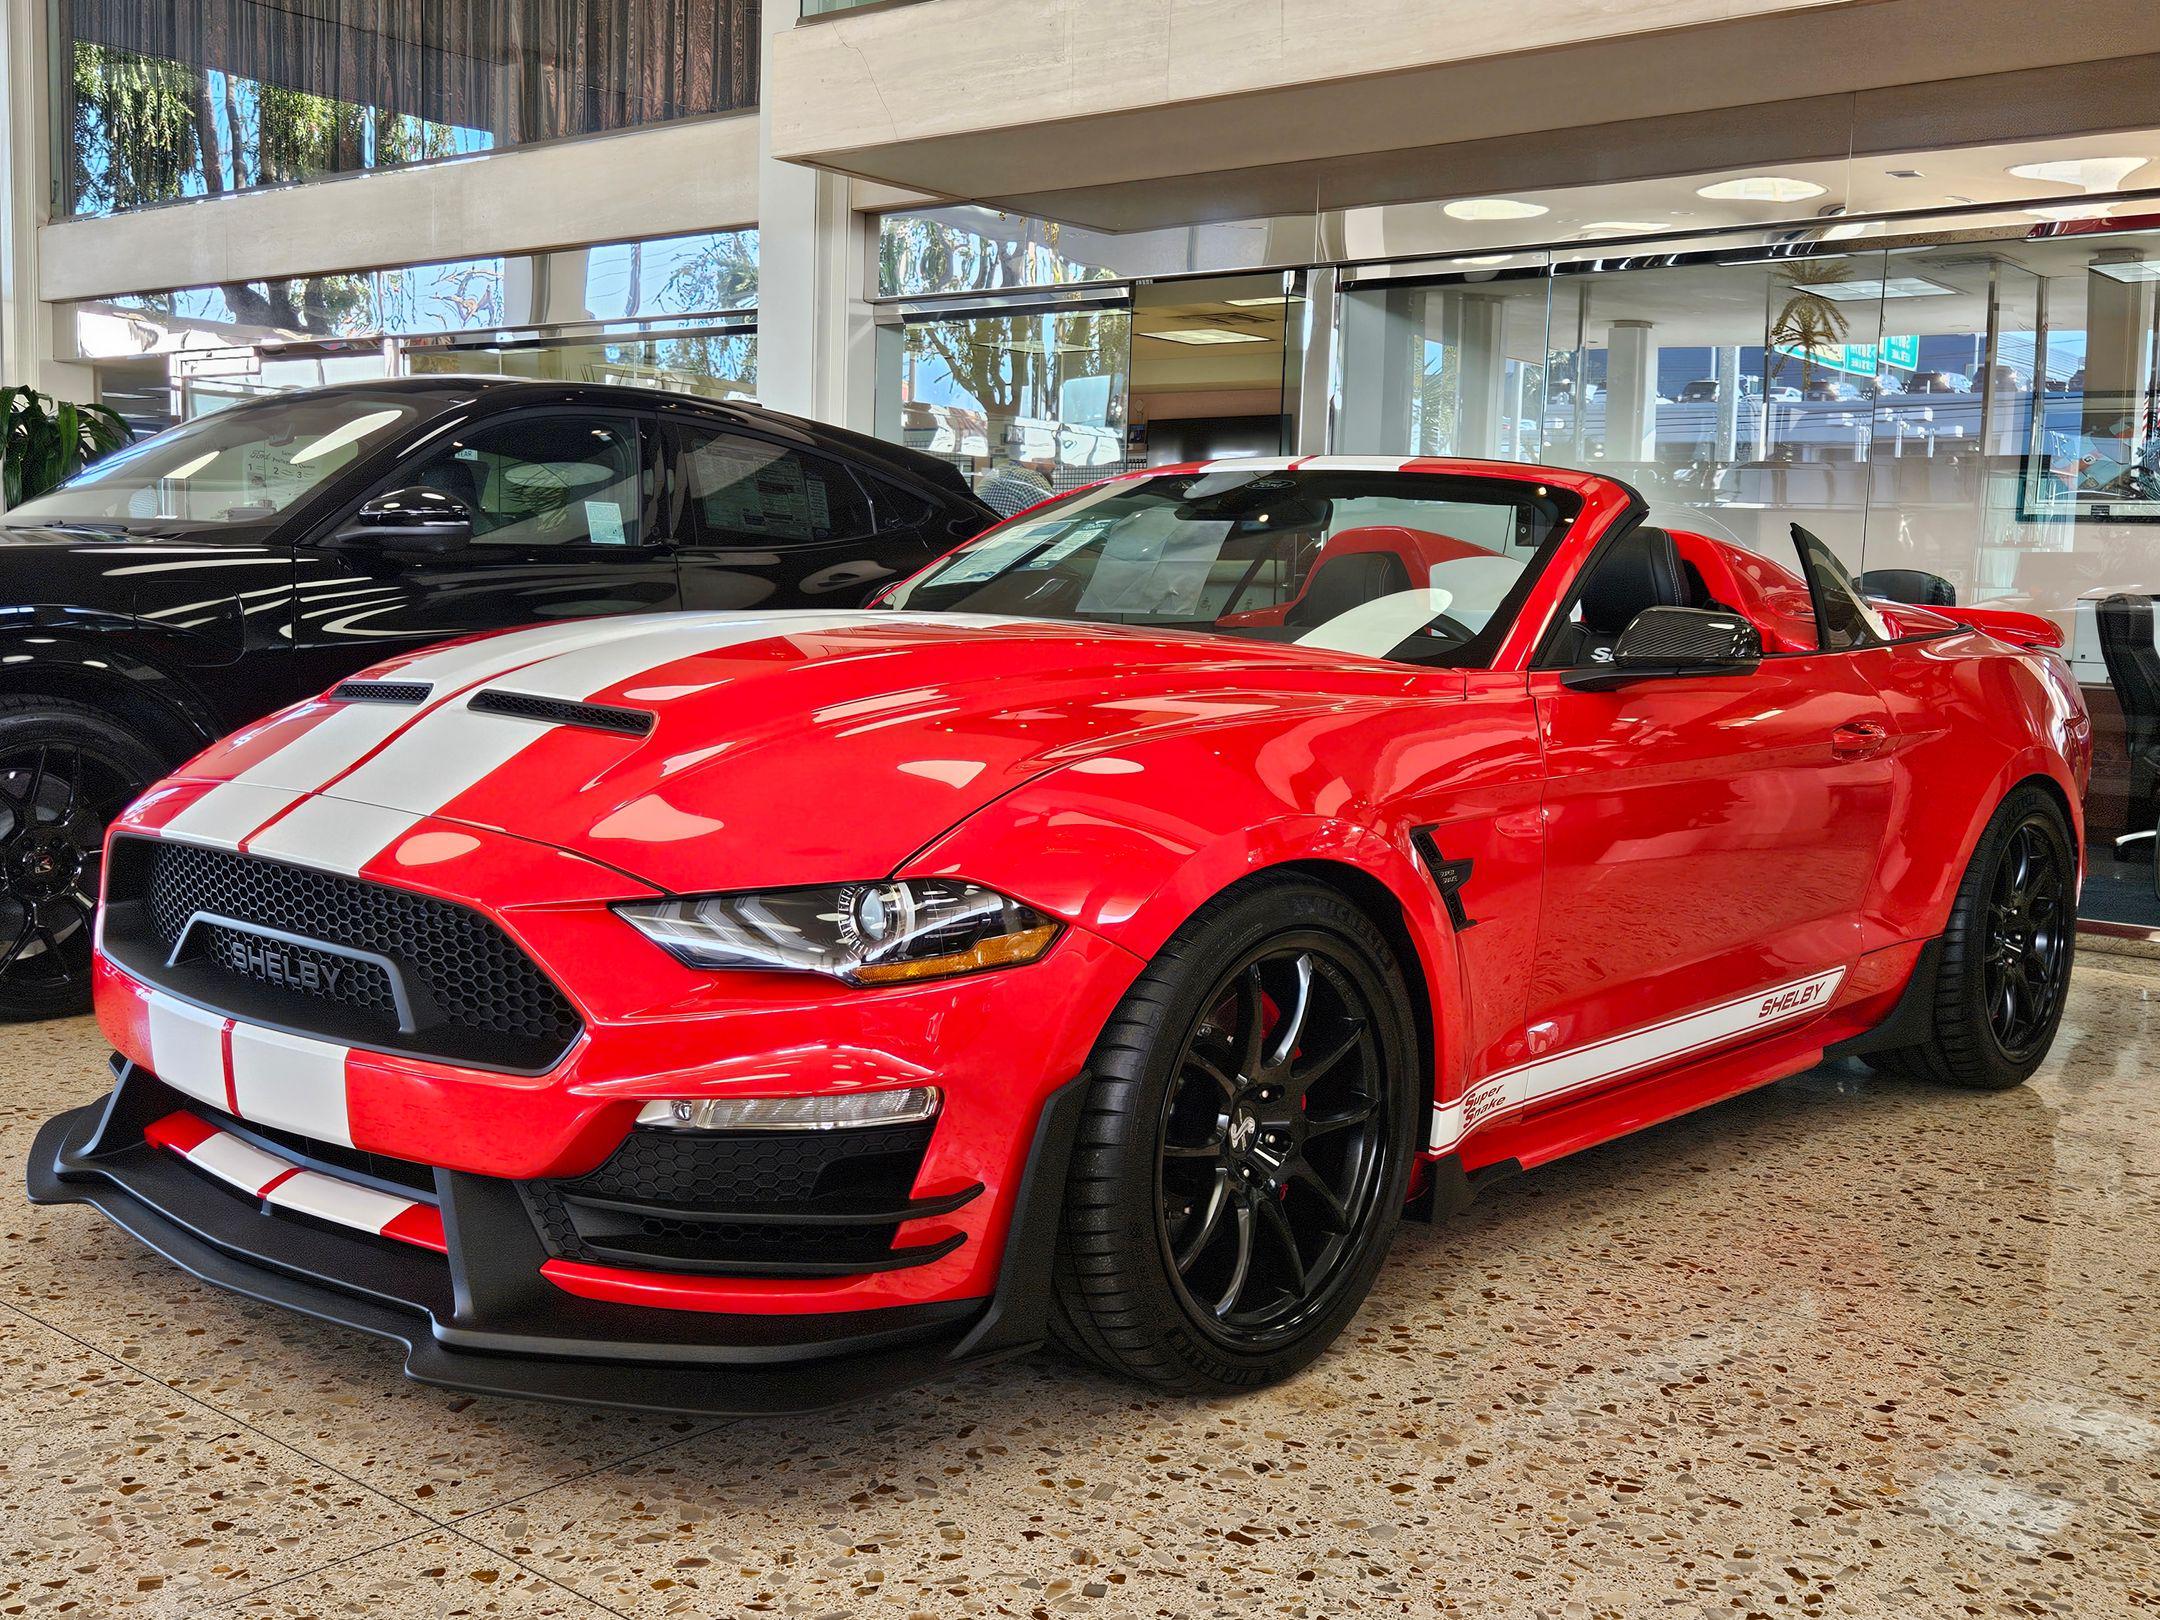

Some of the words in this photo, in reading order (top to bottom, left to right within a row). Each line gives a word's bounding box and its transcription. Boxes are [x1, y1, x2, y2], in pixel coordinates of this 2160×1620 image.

[273, 466, 279, 475] 2
[296, 471, 302, 479] 3
[232, 941, 341, 994] SHELBY
[1758, 981, 1826, 1018] SHELBY
[1463, 1084, 1505, 1115] Super
[1463, 1096, 1506, 1129] Snake
